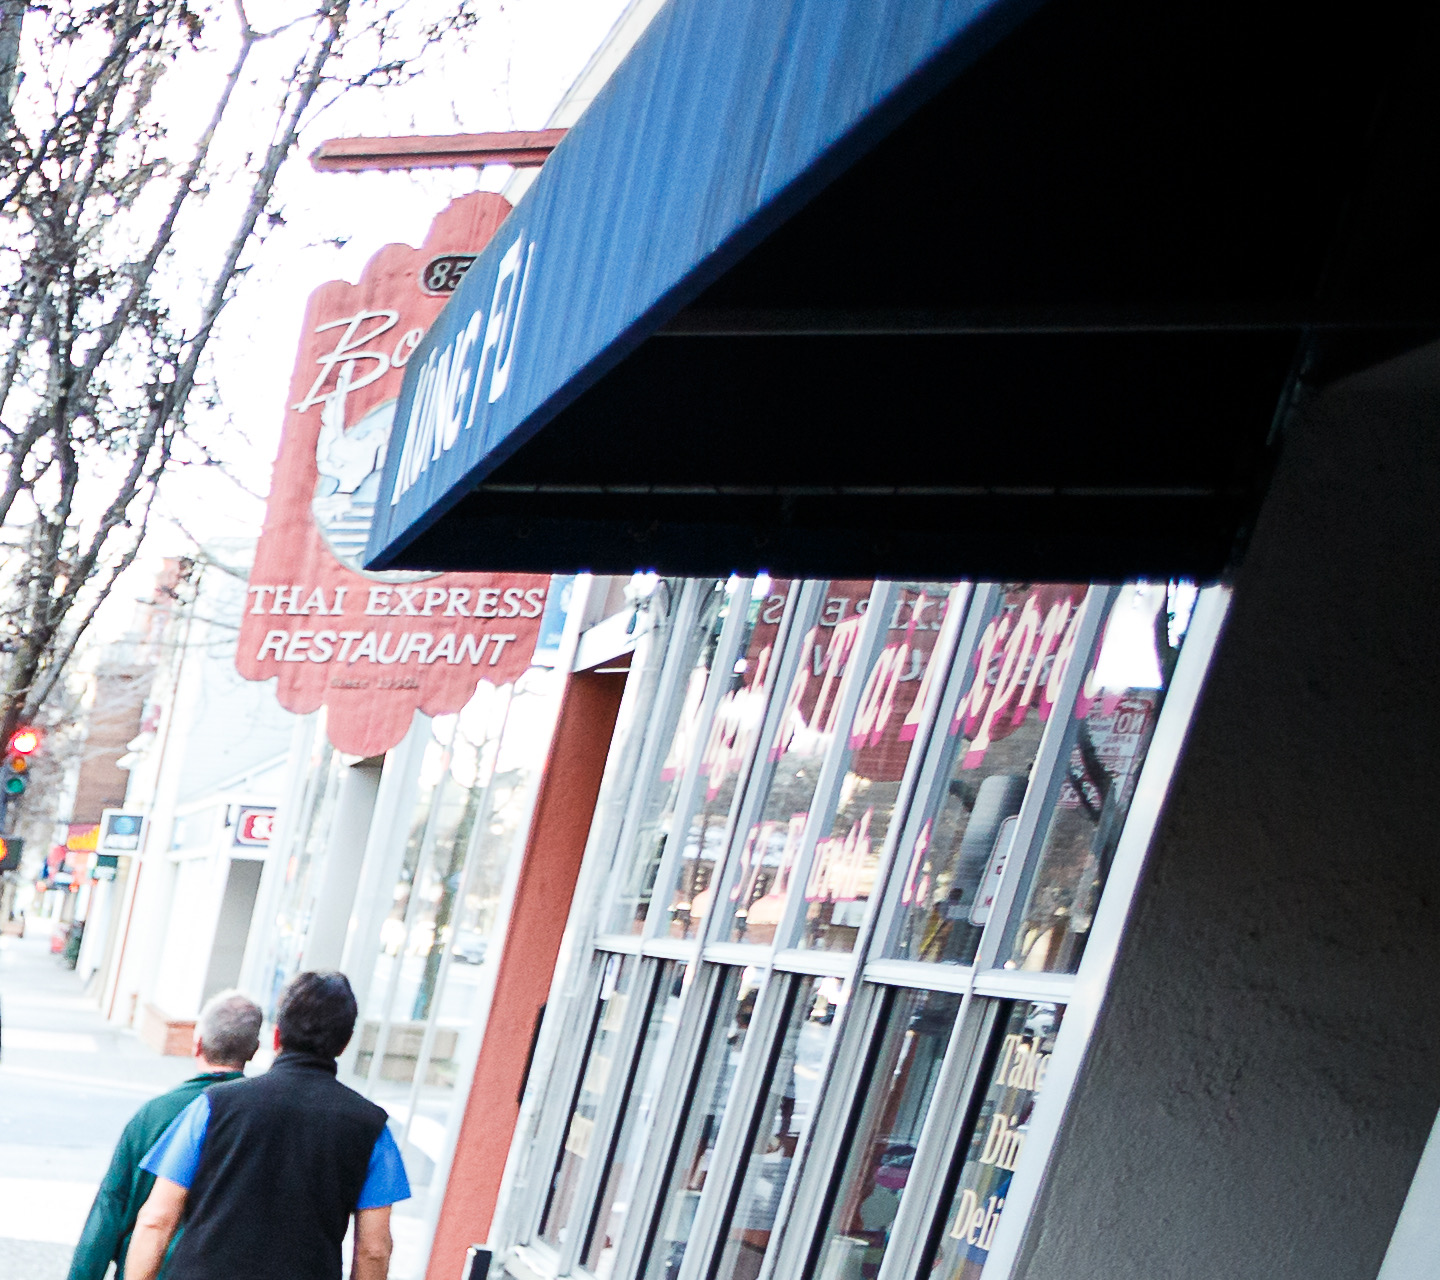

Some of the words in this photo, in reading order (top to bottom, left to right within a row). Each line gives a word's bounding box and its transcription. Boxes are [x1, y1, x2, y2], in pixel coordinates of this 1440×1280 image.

[390, 309, 482, 506] KUNG
[465, 229, 536, 430] FU
[248, 585, 348, 616] THAI
[363, 586, 546, 618] EXPRESS
[255, 629, 517, 666] RESTAURANT
